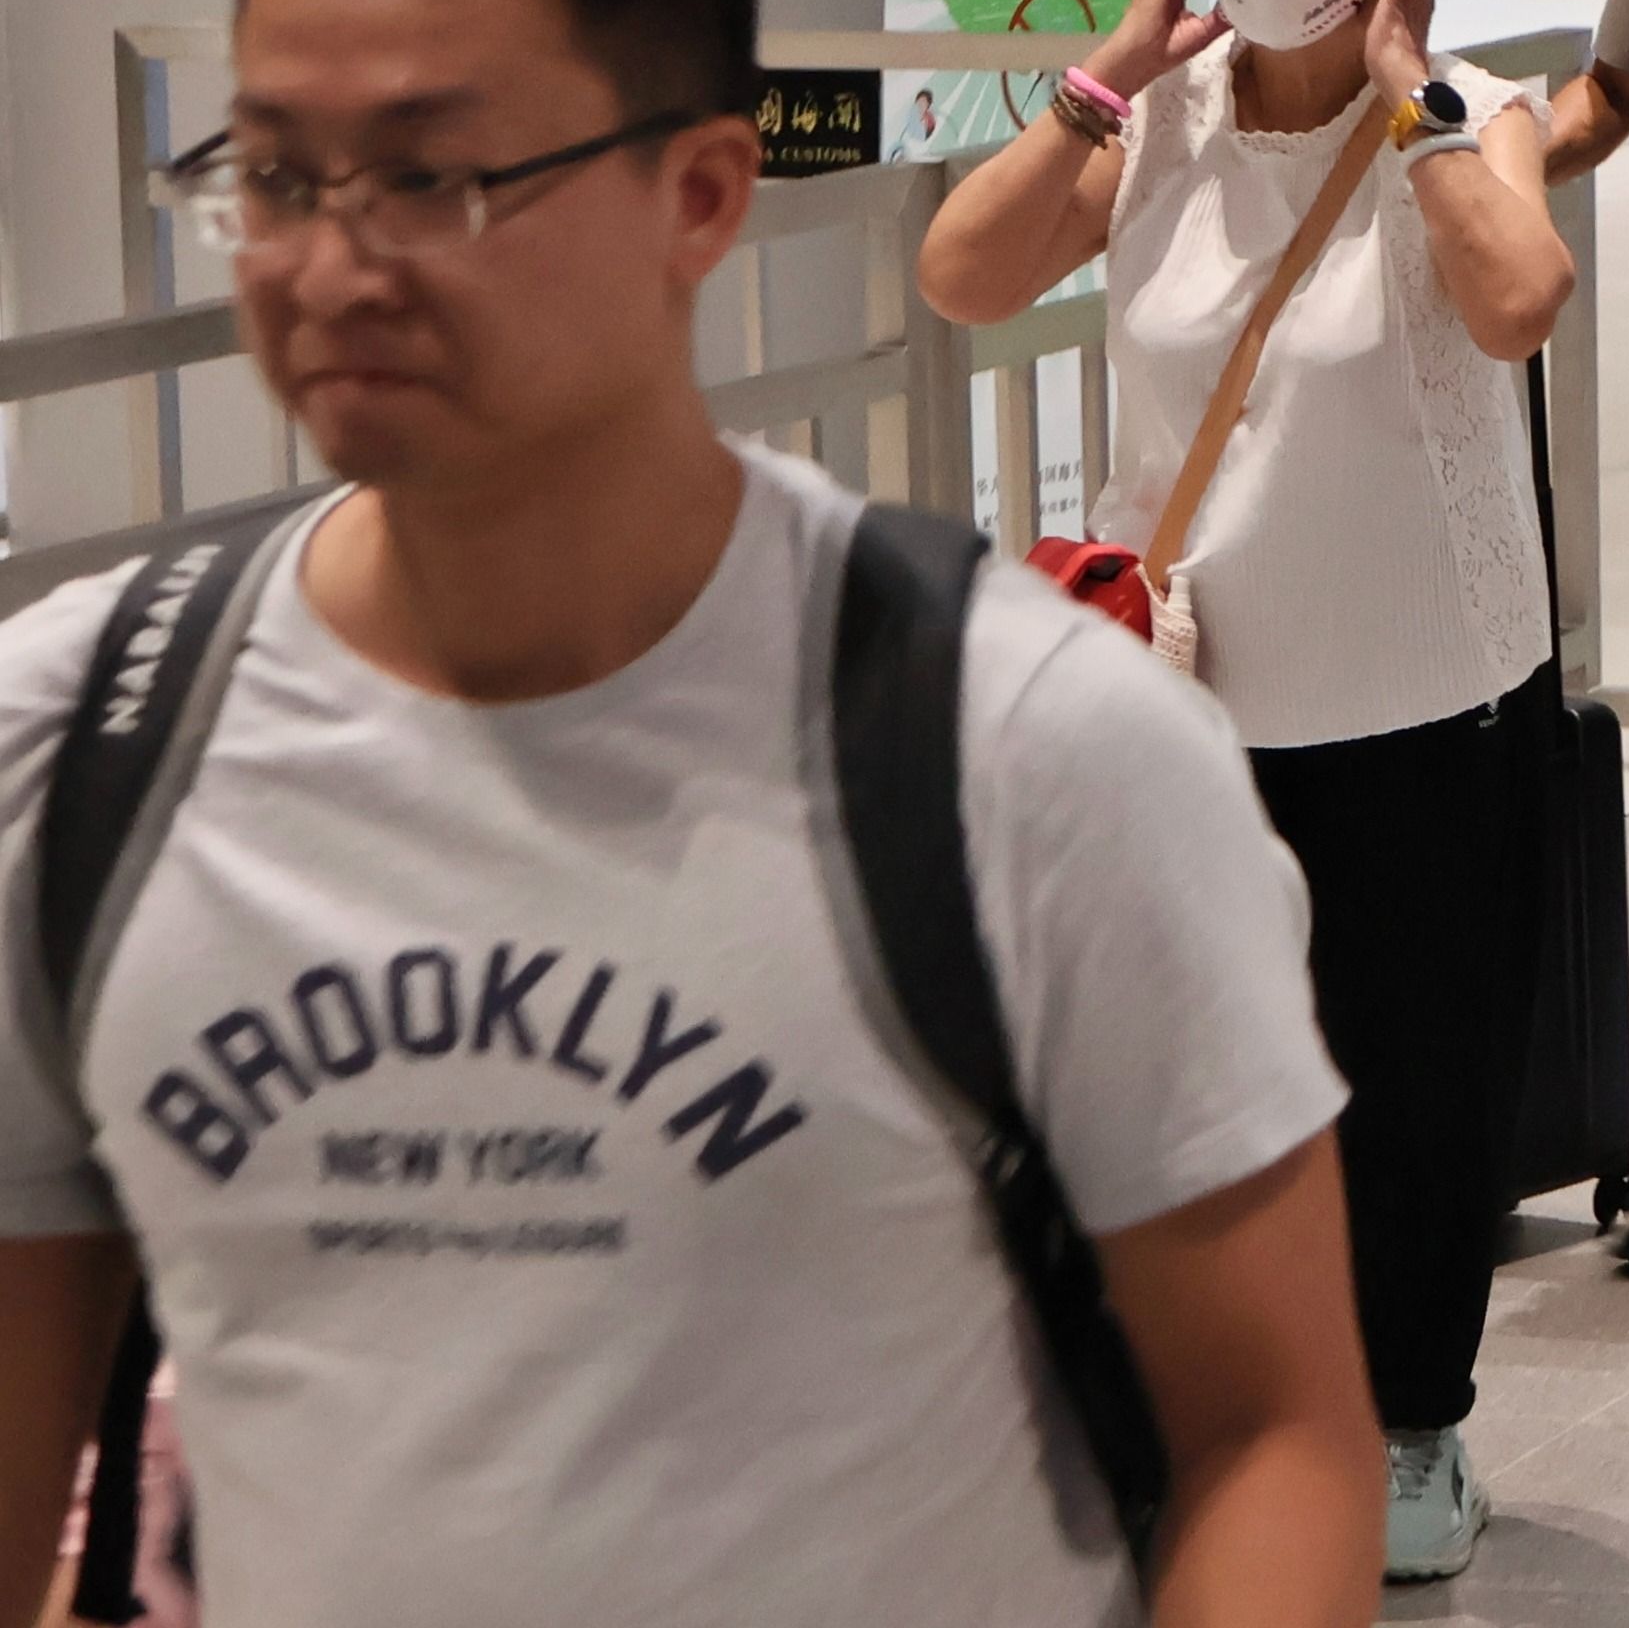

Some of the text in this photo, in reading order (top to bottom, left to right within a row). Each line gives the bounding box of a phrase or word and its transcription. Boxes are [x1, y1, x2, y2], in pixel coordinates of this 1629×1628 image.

[140, 940, 810, 1184] BROOKLYN
[318, 1125, 604, 1187] NEW YORK
